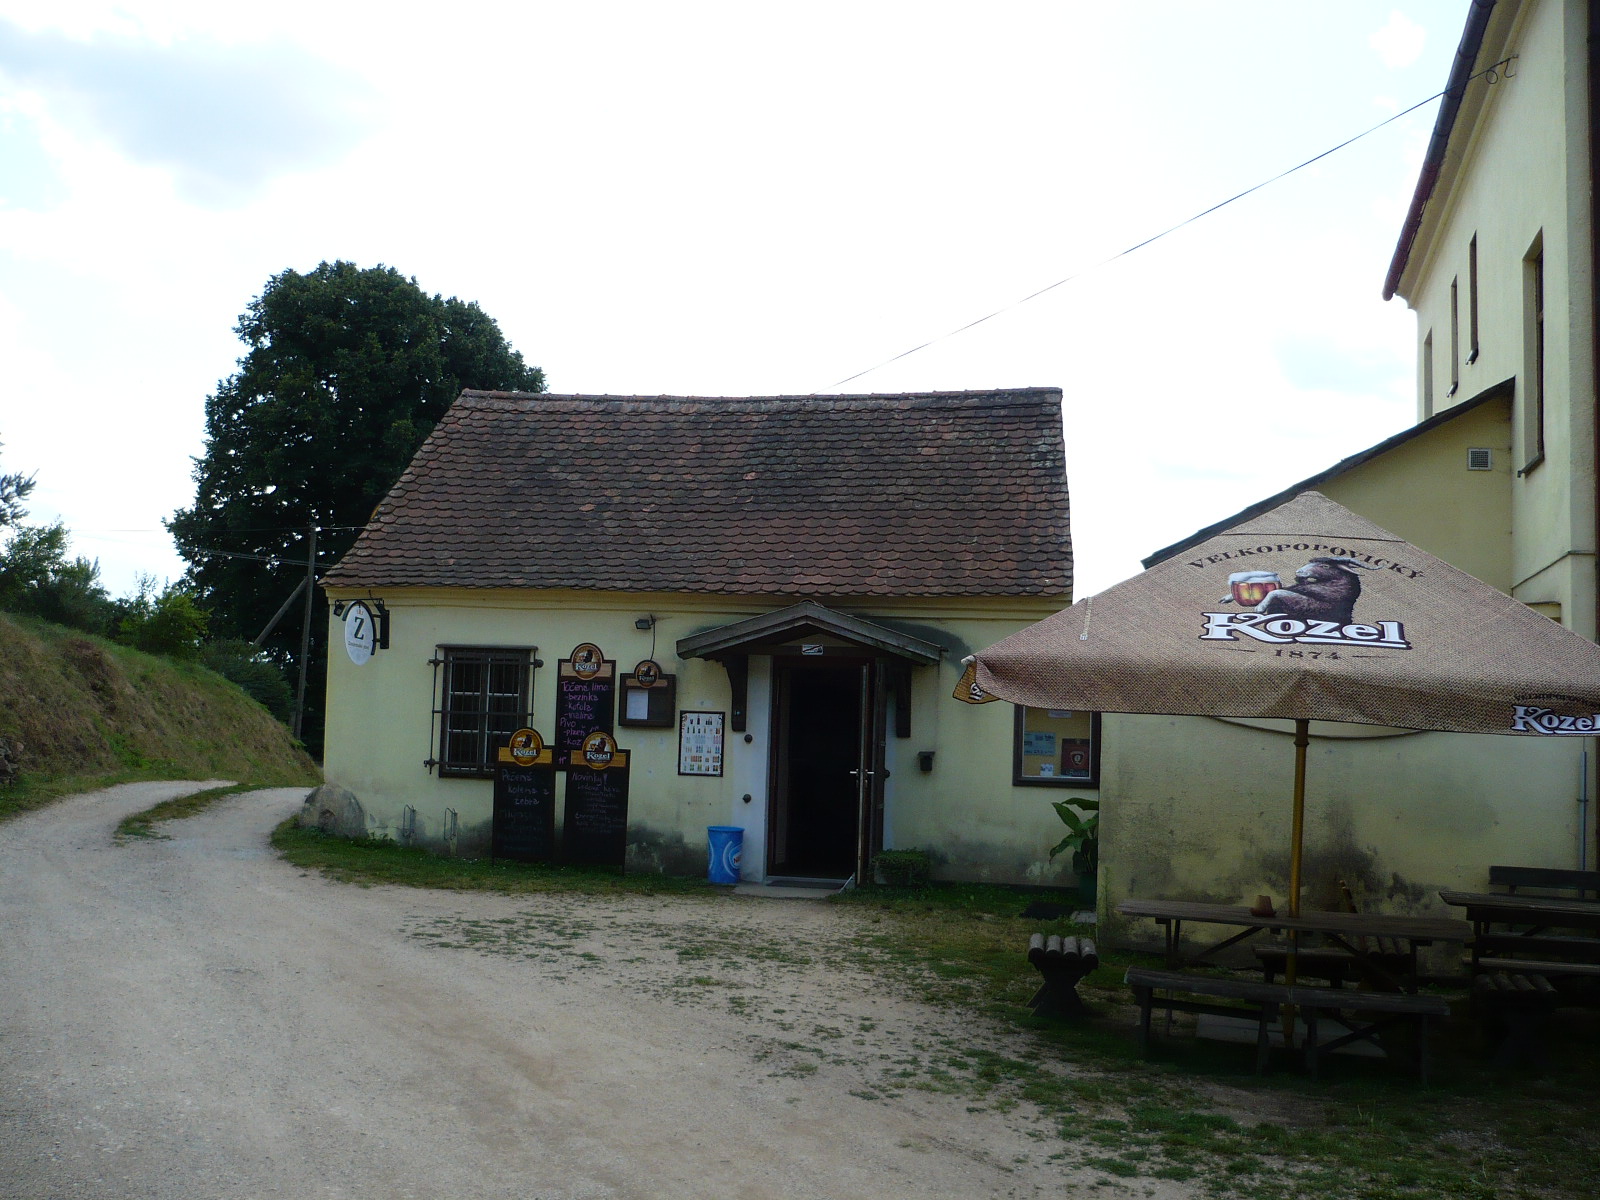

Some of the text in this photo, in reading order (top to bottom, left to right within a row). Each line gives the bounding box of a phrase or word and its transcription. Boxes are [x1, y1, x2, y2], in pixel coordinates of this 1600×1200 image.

[354, 617, 364, 640] Z
[1200, 612, 1412, 650] Kozel
[1511, 705, 1600, 734] Kozel
[586, 751, 610, 760] Kozel
